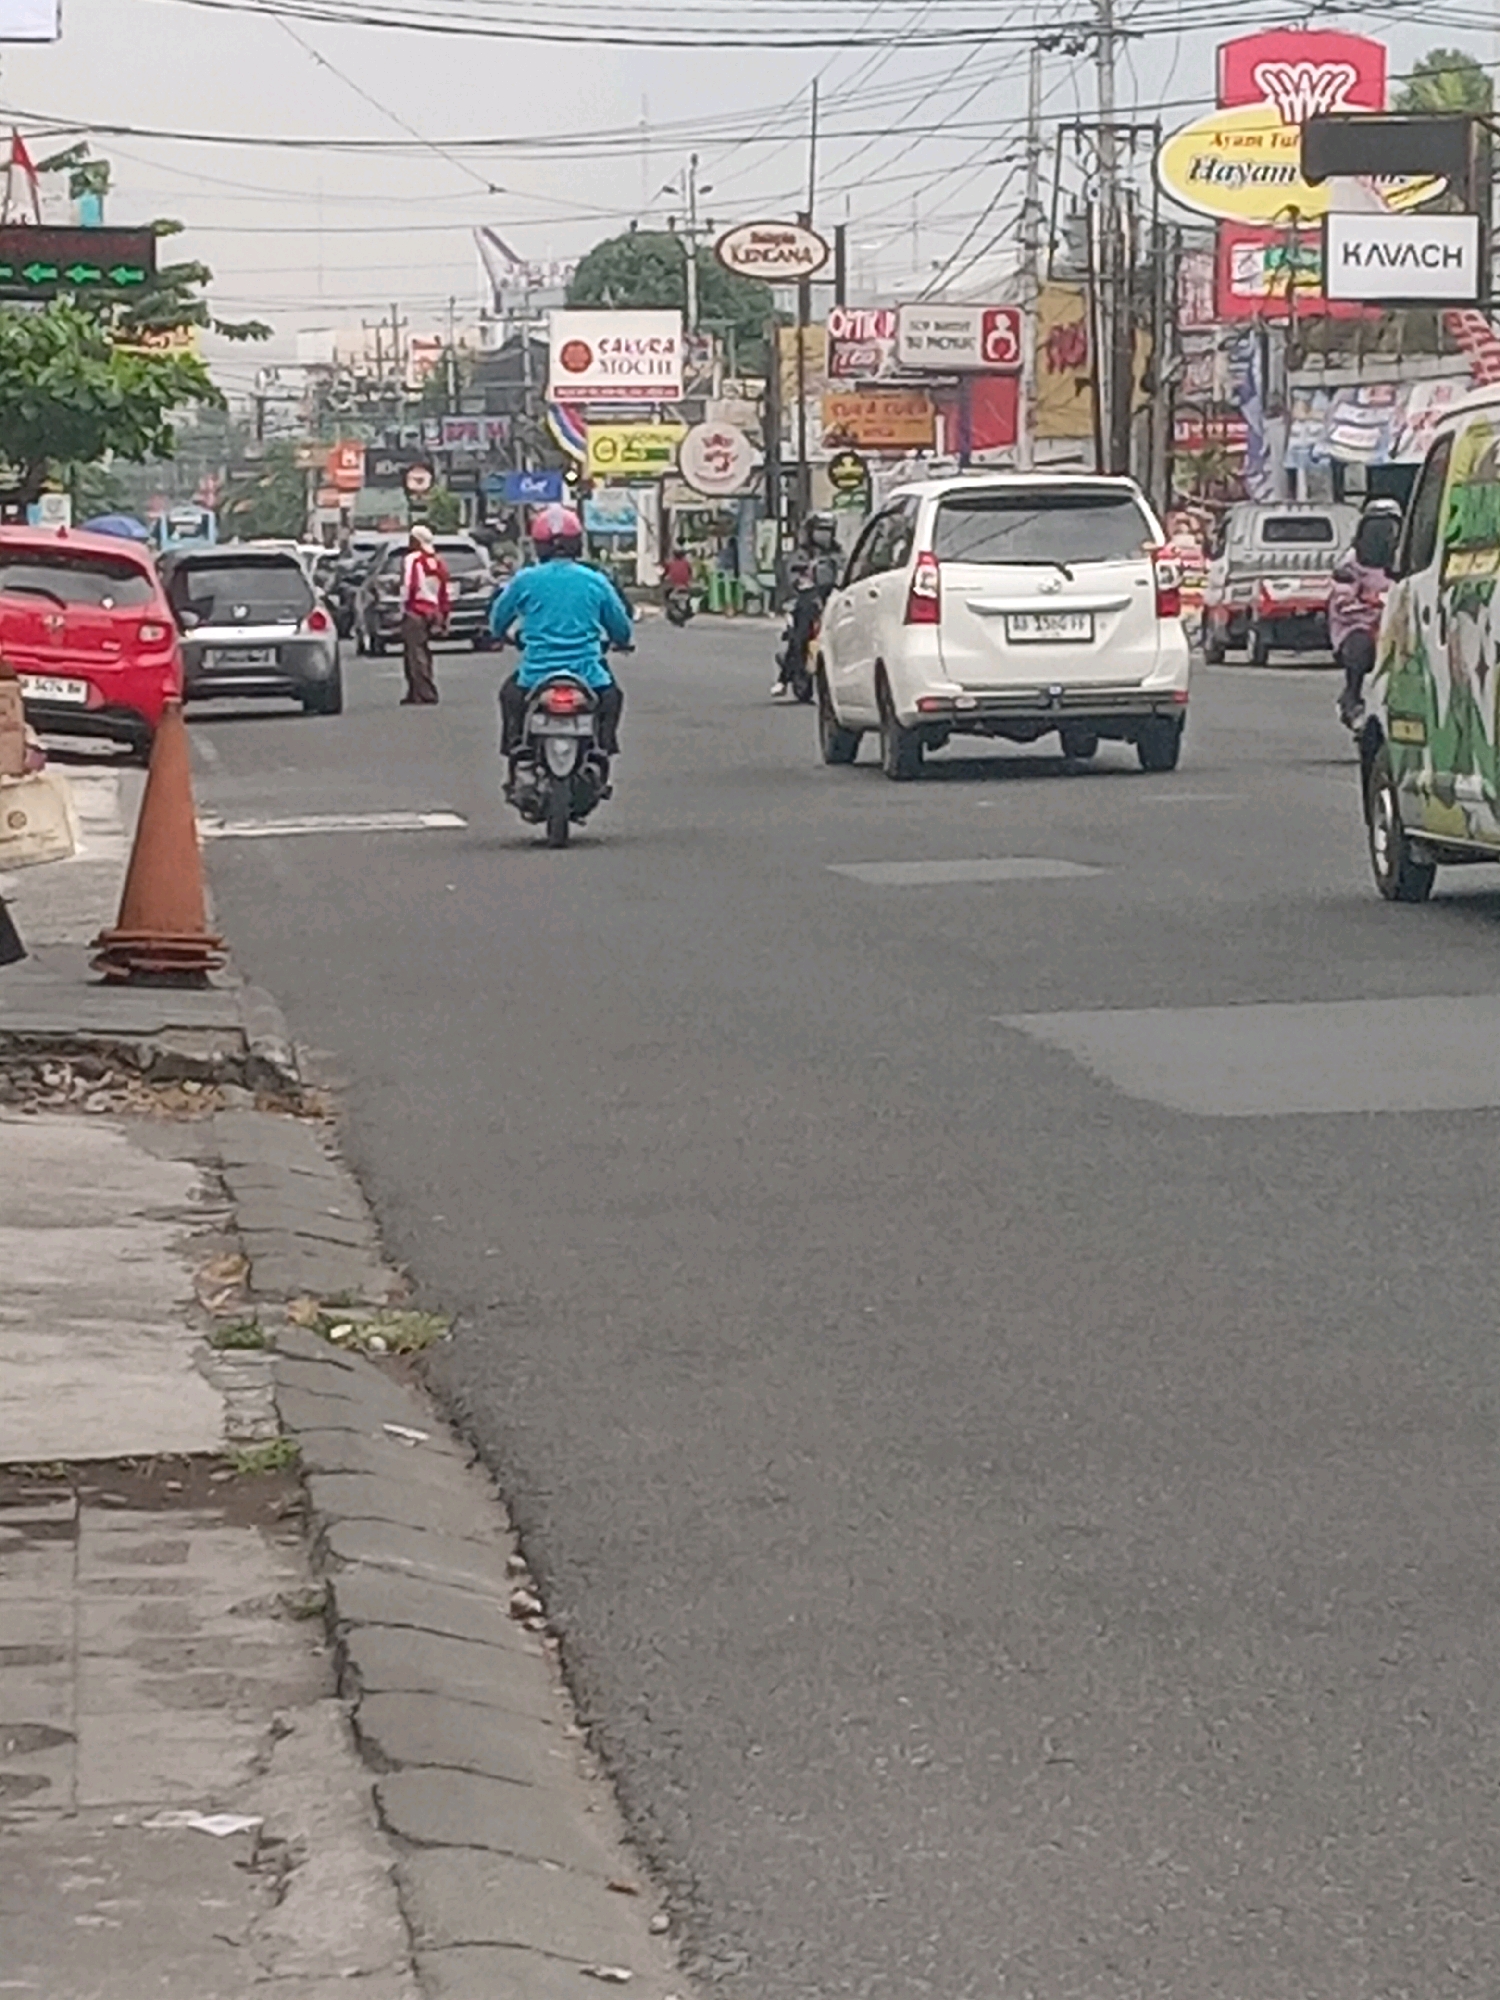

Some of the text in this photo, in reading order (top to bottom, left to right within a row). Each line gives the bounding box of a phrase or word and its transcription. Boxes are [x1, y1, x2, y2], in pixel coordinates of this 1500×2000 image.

[1210, 133, 1263, 150] Ayam
[1189, 157, 1296, 189] Hayam
[730, 244, 814, 264] KENCANA
[1342, 242, 1463, 268] KAVACH
[598, 337, 675, 354] SAKURA
[599, 359, 672, 375] MOCHI
